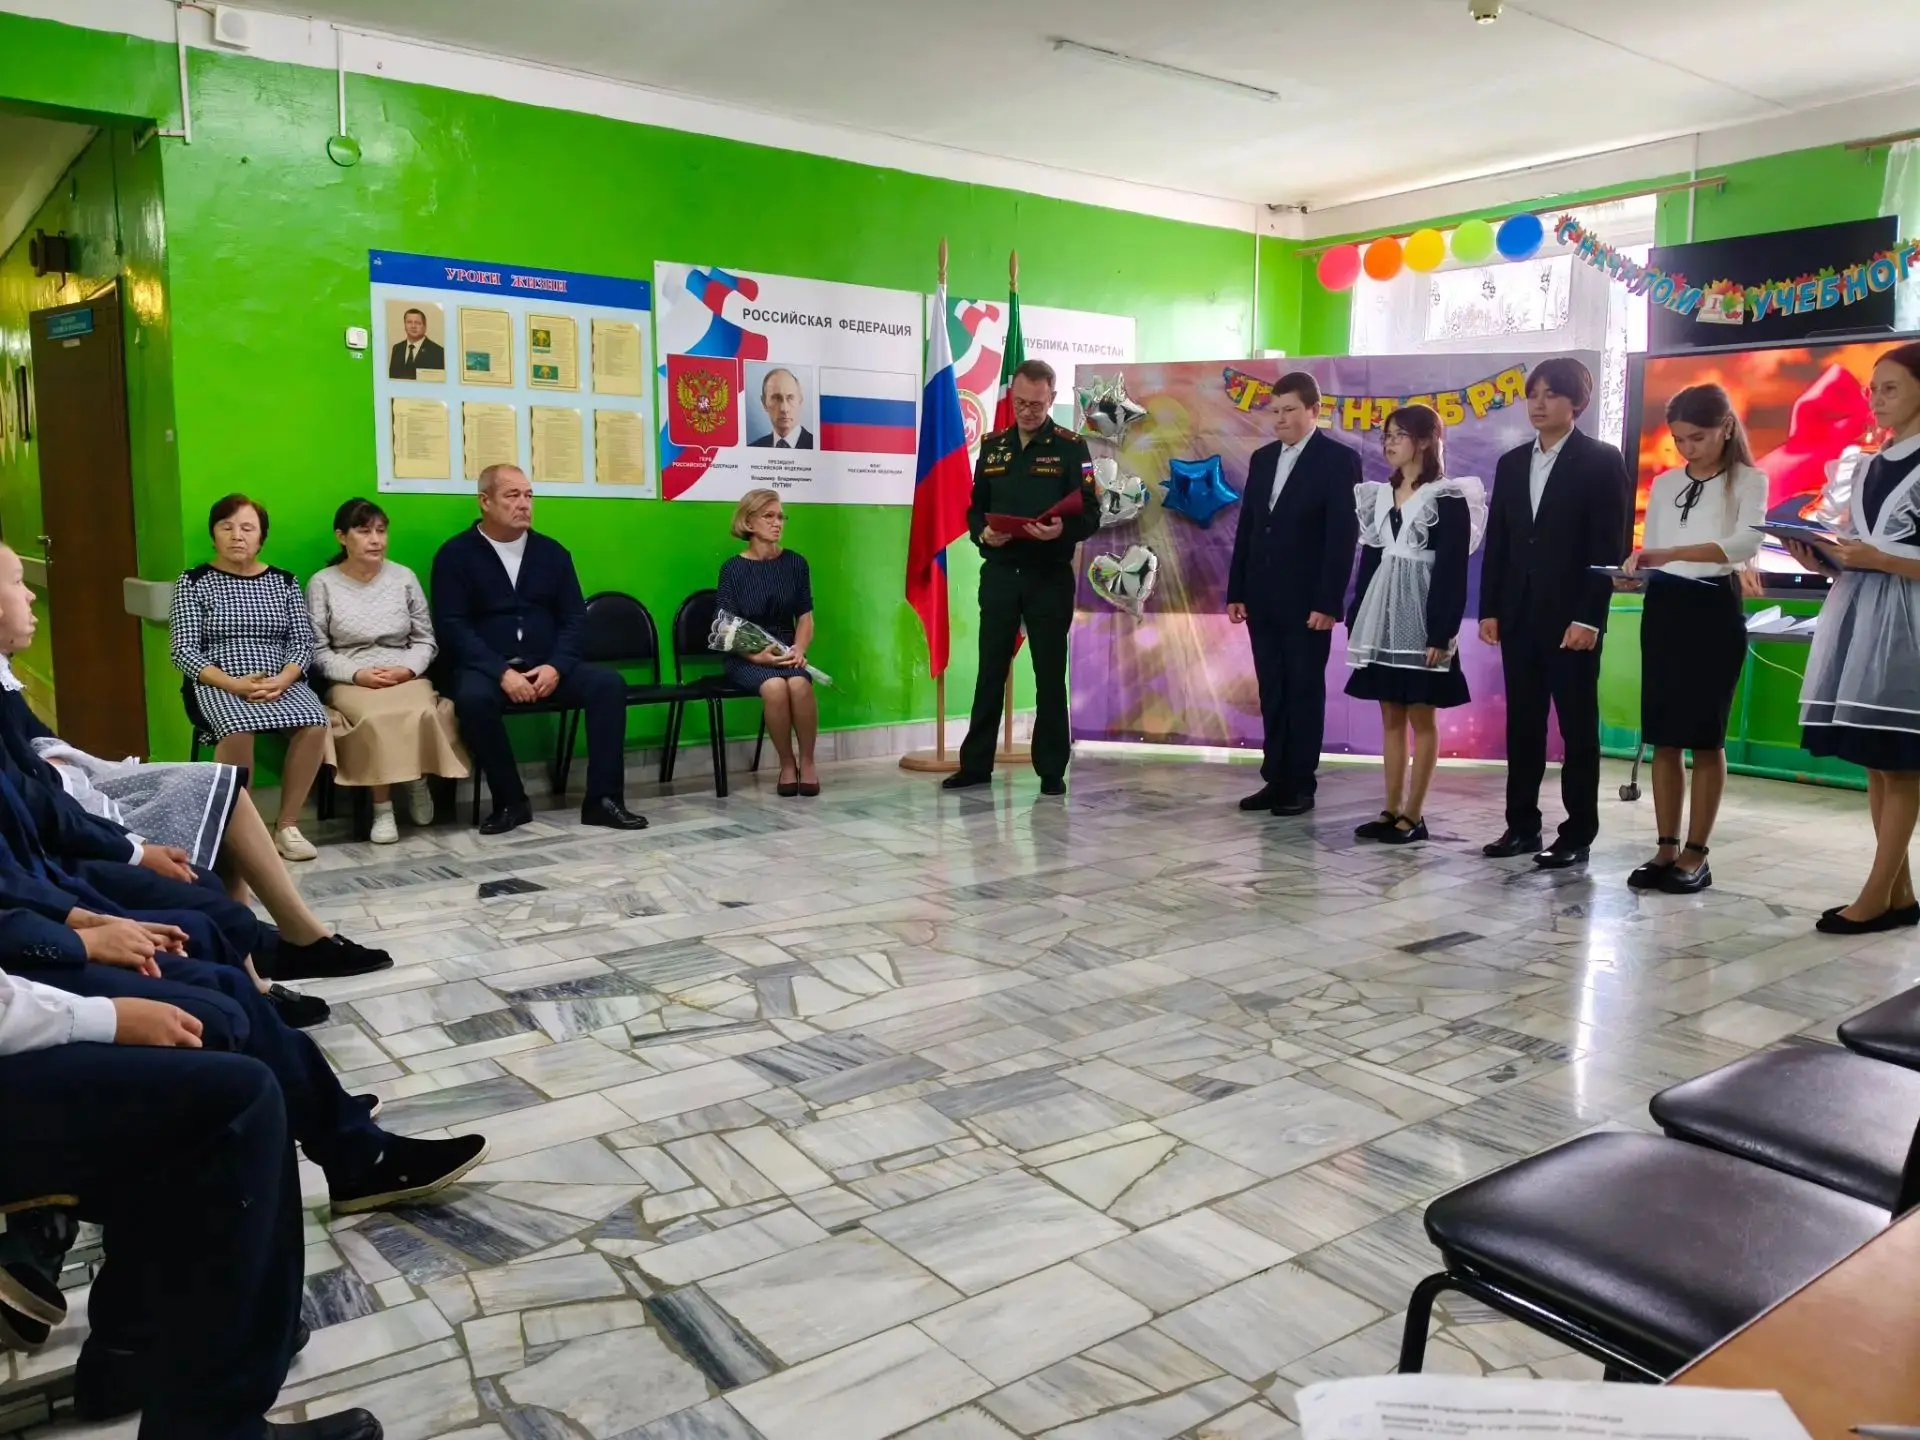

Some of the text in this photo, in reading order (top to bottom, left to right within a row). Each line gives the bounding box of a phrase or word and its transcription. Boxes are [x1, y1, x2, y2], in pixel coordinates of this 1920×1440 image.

[444, 267, 568, 293] УРОКИ ЖИЗНИ
[1574, 234, 1703, 316] НАЧАЛОМ
[742, 307, 912, 337] РОССИЙСКАЯ ФЕДЕРАЦИЯ
[1001, 335, 1124, 357] РПУБЛИКА ТАТАРСТАН
[1316, 368, 1527, 431] ЕНТБРЯ
